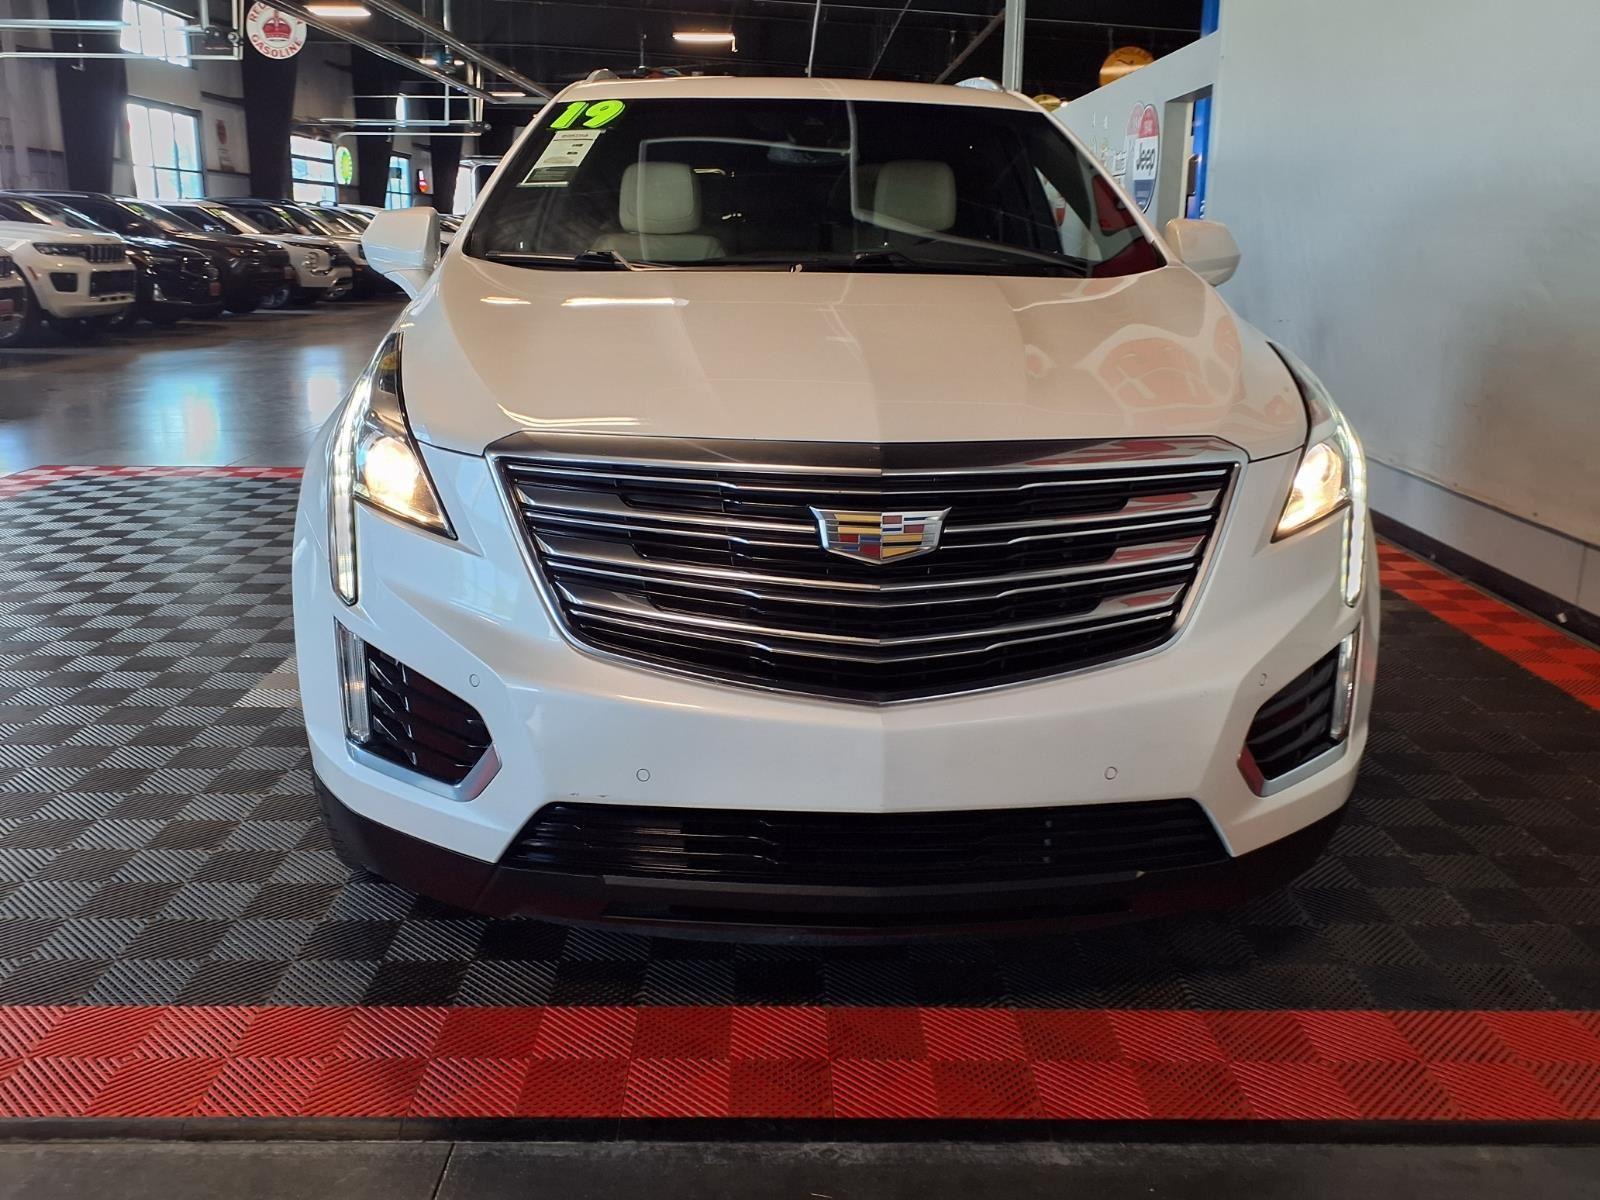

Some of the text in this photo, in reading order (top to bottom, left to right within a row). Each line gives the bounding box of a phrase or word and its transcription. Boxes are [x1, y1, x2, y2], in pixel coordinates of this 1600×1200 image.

[251, 34, 303, 57] GASOLINE
[549, 100, 626, 129] 19
[1136, 143, 1155, 175] Jeep
